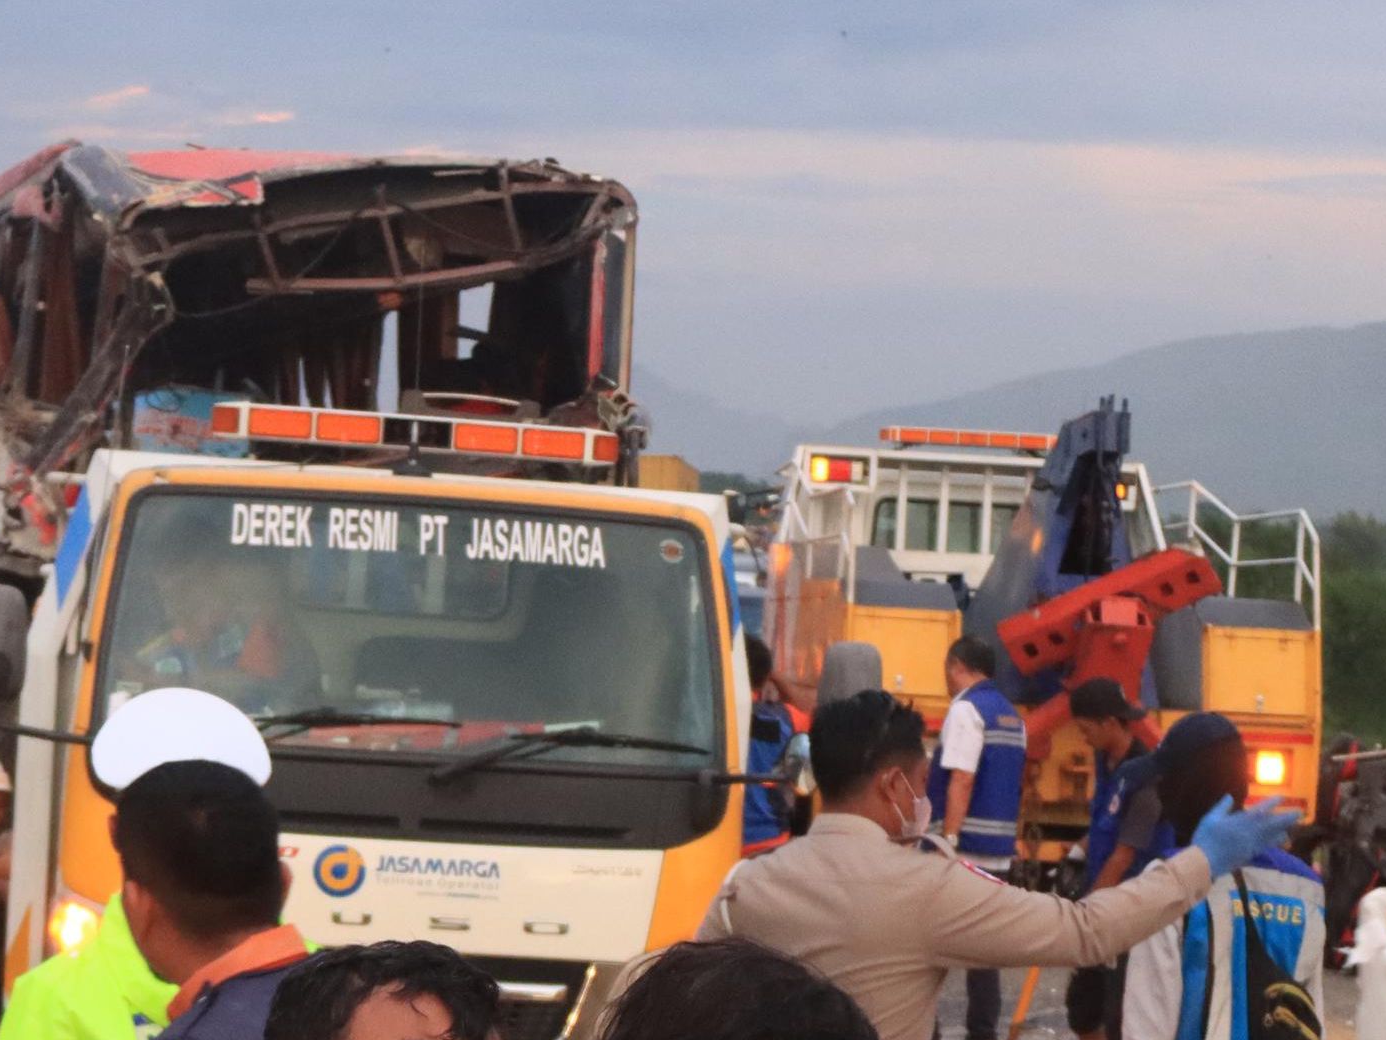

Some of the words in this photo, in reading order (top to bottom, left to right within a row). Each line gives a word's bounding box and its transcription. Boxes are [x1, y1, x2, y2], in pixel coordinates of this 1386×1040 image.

[230, 503, 312, 548] DEREK
[328, 507, 399, 552] RESMI
[419, 514, 449, 556] PT
[465, 517, 606, 568] JASAMARGA
[375, 854, 501, 879] JASAMARGA
